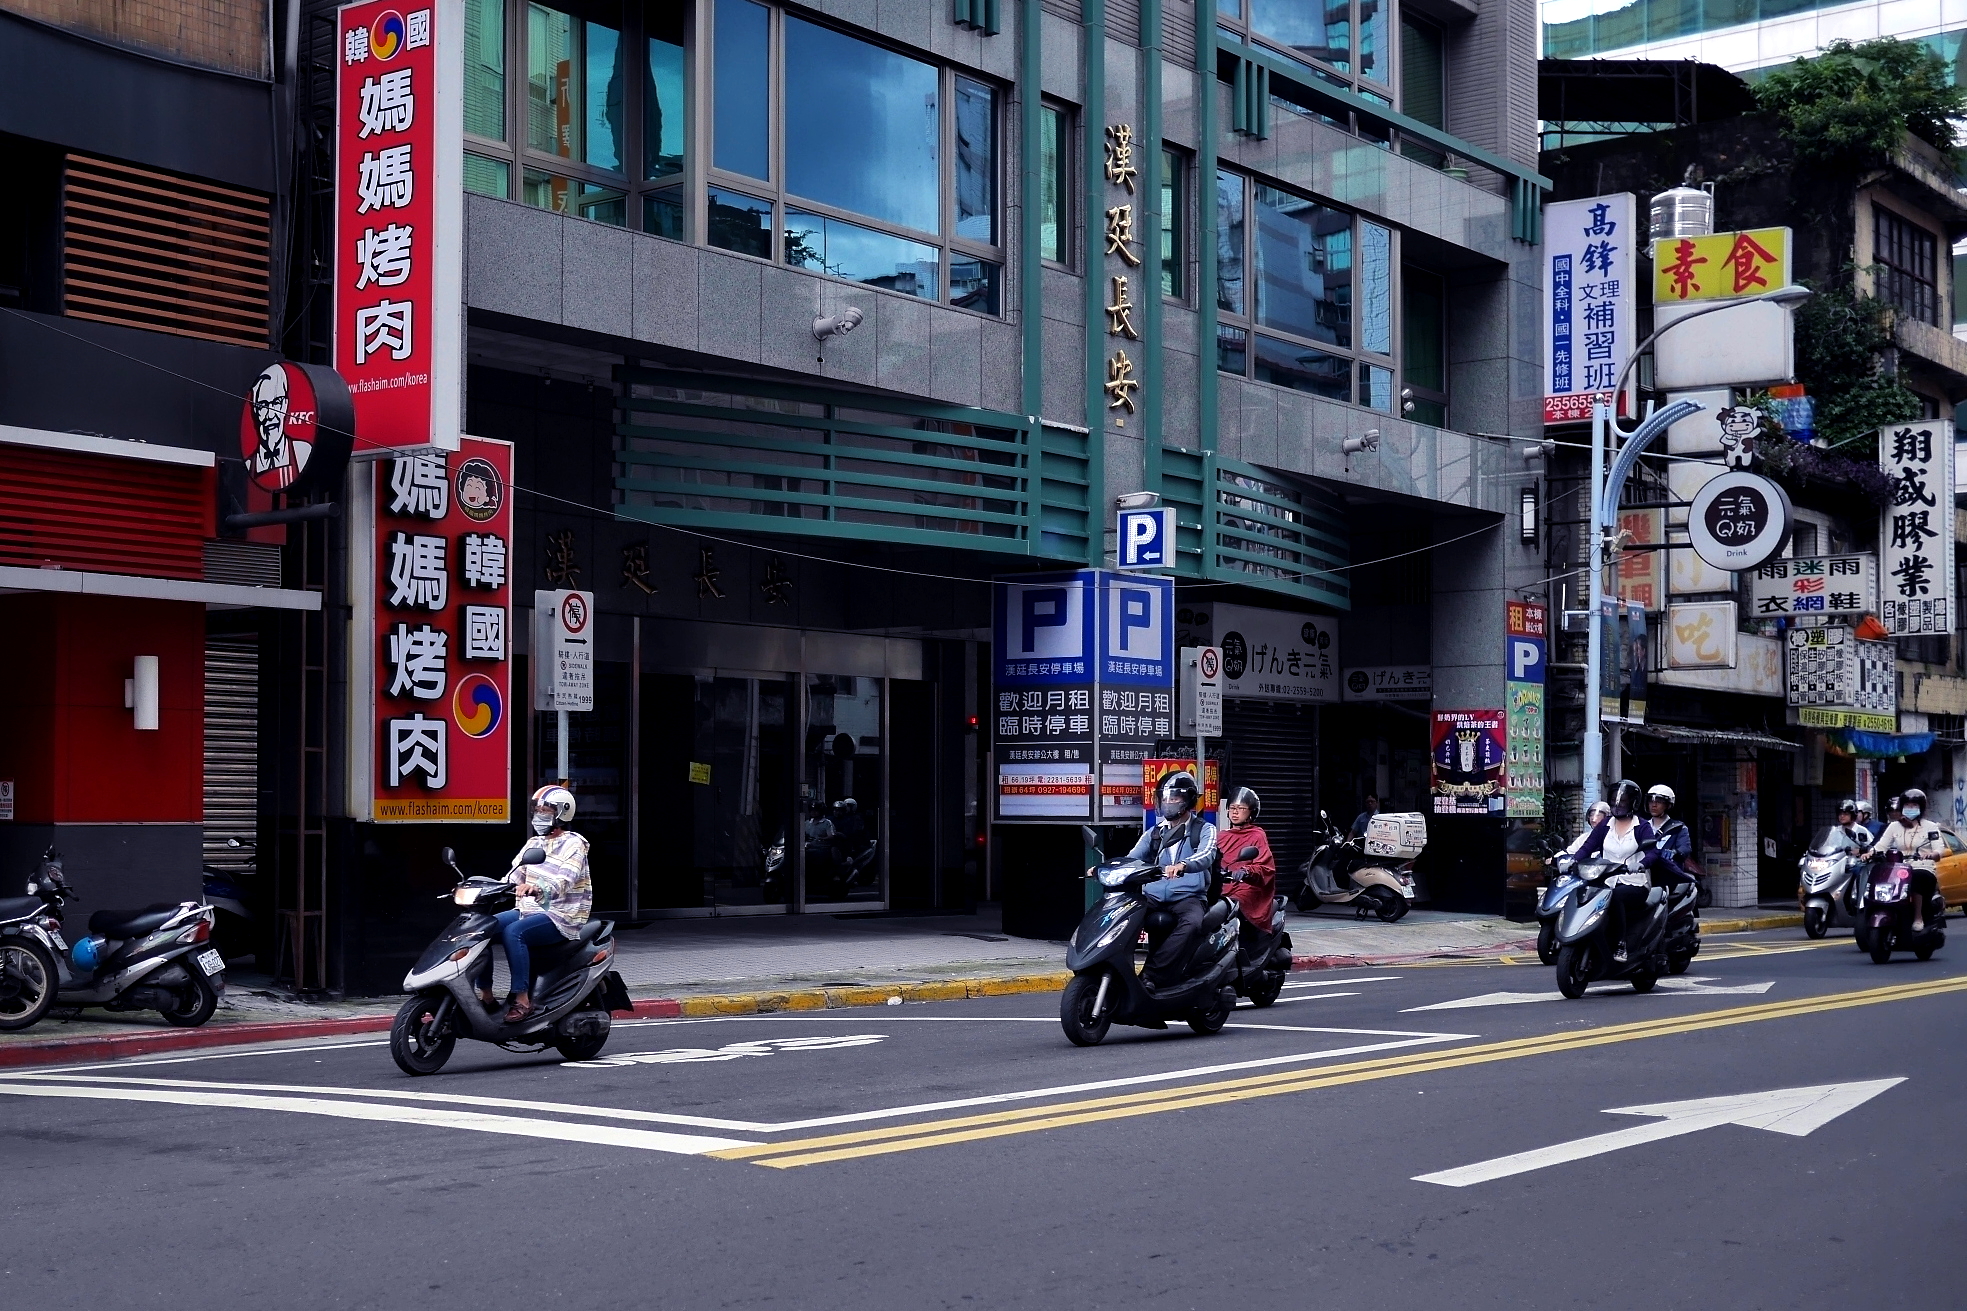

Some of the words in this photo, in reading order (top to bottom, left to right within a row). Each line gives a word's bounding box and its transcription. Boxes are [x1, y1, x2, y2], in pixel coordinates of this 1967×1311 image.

[356, 67, 415, 365] 媽媽烤肉
[1661, 234, 1778, 299] 素食
[1583, 301, 1616, 392] 補習班
[1546, 393, 1611, 411] 2556555
[289, 410, 315, 425] KFC
[1719, 495, 1756, 516] 元氣
[1890, 427, 1939, 598] 翔盛膠業
[1127, 514, 1156, 564] P
[1716, 519, 1756, 537] Q奶
[1726, 549, 1748, 558] Drink
[464, 533, 507, 662] 韓國
[389, 450, 449, 790] 媽媽烤肉
[1022, 588, 1067, 652] P
[1120, 588, 1151, 651] P
[1509, 606, 1523, 631] 租
[1005, 662, 1085, 677] 漢廷長安停車場
[1108, 661, 1163, 677] 漢廷長安停車場
[1252, 643, 1332, 680] げんき元氣
[1514, 641, 1539, 678] P
[999, 689, 1090, 712] 歡迎月租
[1102, 690, 1170, 713] 歡迎月租
[999, 714, 1090, 736] 臨時停車
[1102, 715, 1170, 737] 臨時停車
[380, 801, 503, 817] www.flashaim.com/korea
